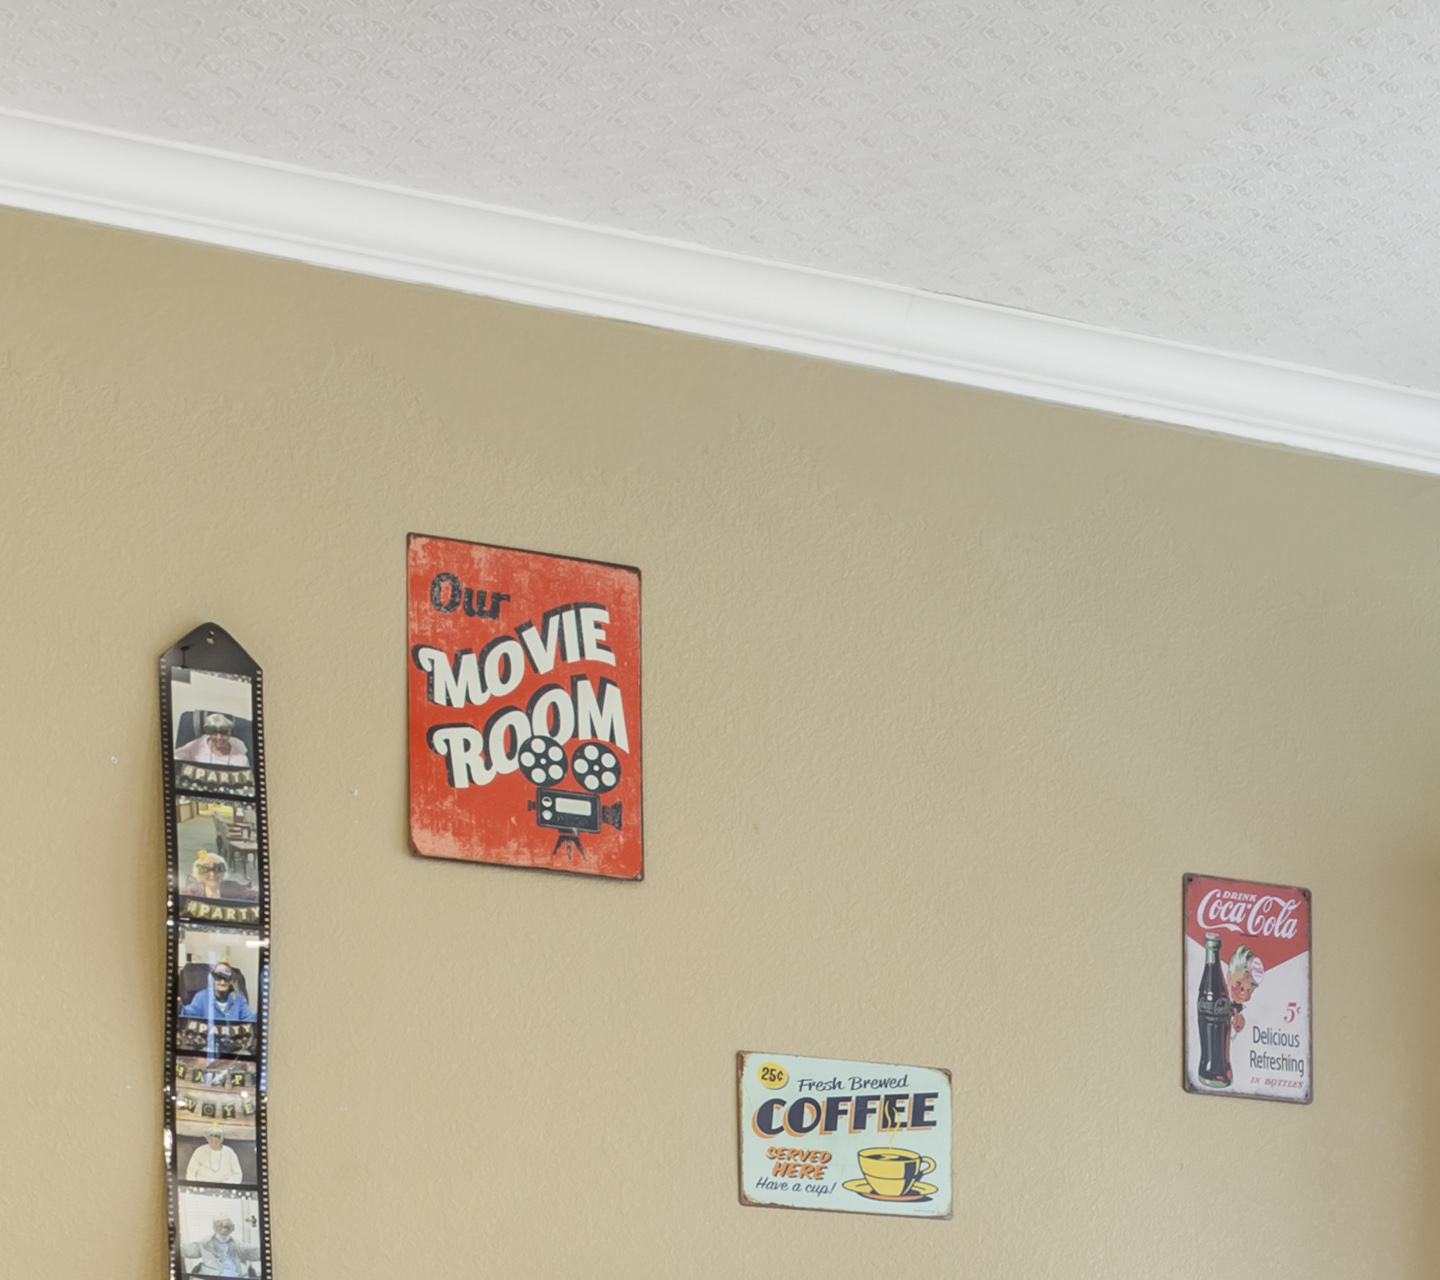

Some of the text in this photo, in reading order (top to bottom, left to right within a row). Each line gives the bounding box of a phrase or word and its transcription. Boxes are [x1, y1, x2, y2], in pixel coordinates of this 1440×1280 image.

[430, 572, 510, 619] Our
[413, 603, 616, 708] MOVIE
[426, 675, 629, 788] ROOM
[183, 765, 251, 783] #PARTY
[1223, 891, 1257, 902] DRINK
[187, 901, 260, 920] #PARTY
[188, 1021, 251, 1035] #PARTY
[1253, 1026, 1300, 1048] Delicious
[1250, 1050, 1304, 1077] Refreshing
[761, 1066, 784, 1083] 25¢
[797, 1074, 909, 1092] Fresh Brewed
[1264, 1078, 1304, 1089] BOTTLES
[752, 1092, 939, 1139] COFFEE
[765, 1146, 833, 1164] SERVED
[772, 1162, 828, 1180] HERE
[756, 1177, 837, 1197] Have a cup!
